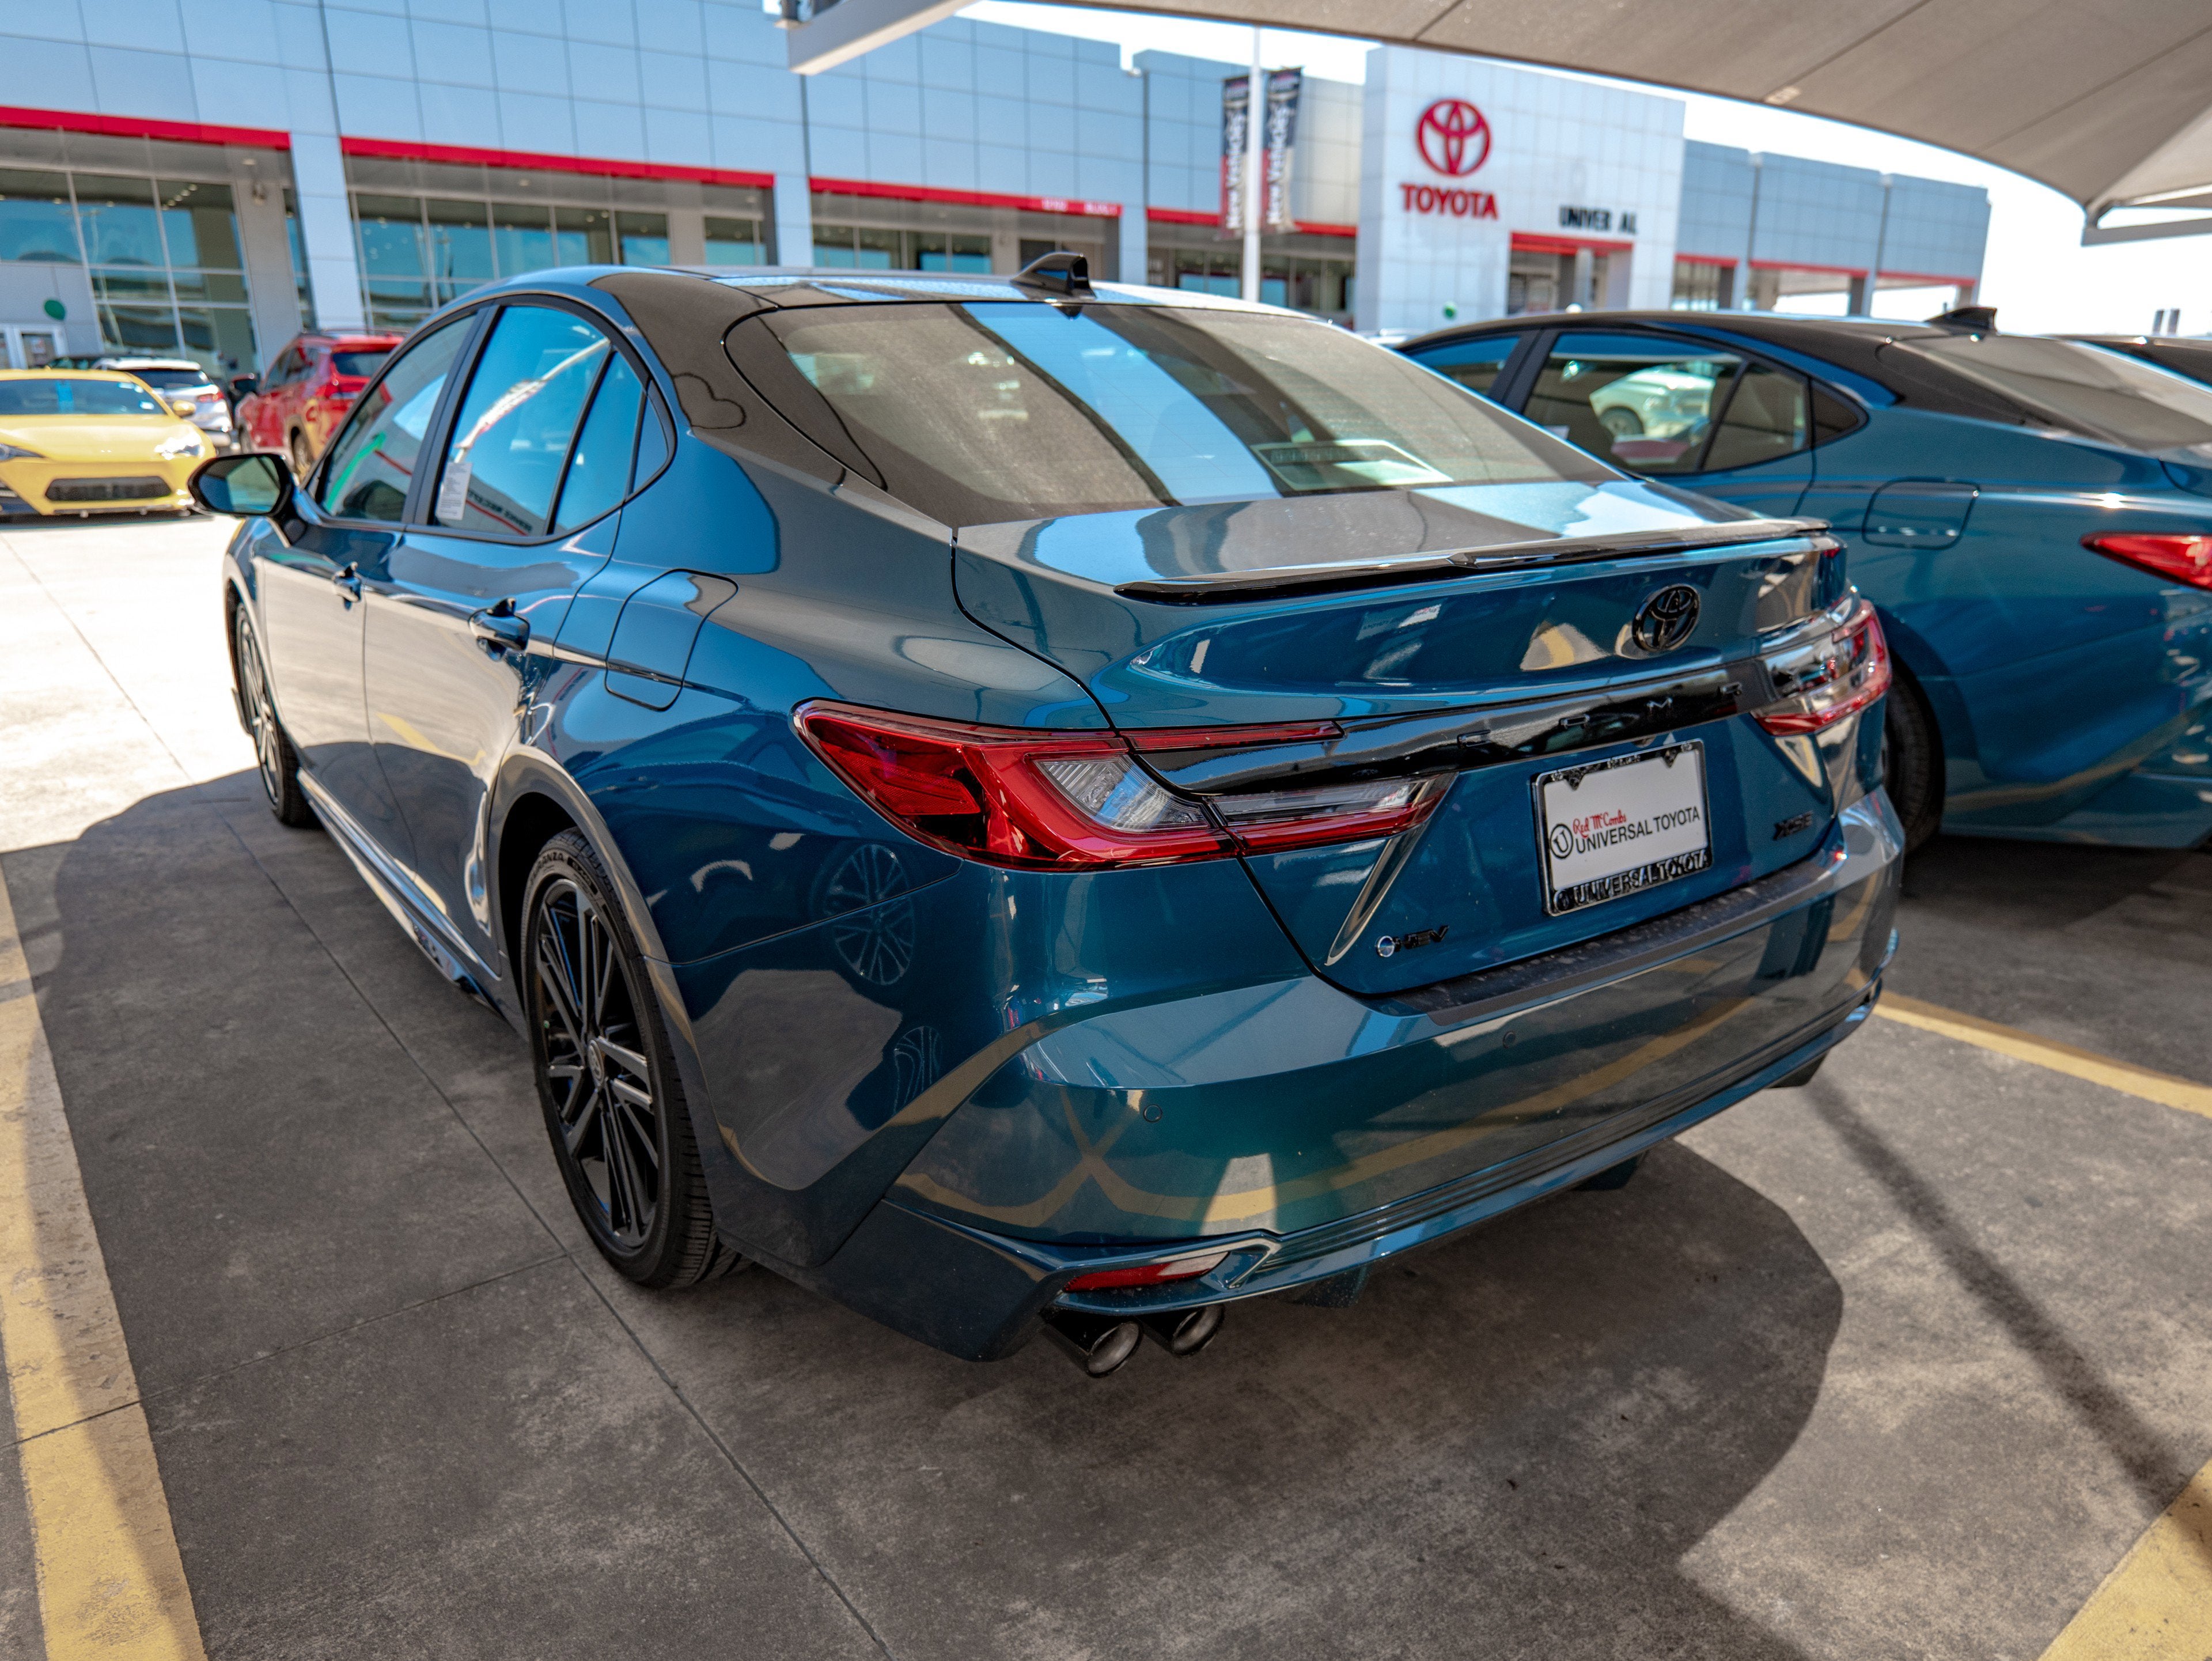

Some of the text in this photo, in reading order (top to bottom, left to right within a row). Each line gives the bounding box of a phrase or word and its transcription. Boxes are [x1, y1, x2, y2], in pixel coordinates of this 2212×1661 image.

[1400, 183, 1498, 221] TOYOTA
[1573, 817, 1590, 839] Red
[1575, 805, 1700, 854] UNIVERSAL TOYOTA
[1573, 849, 1709, 906] UNIVERSAL TOYOTA
